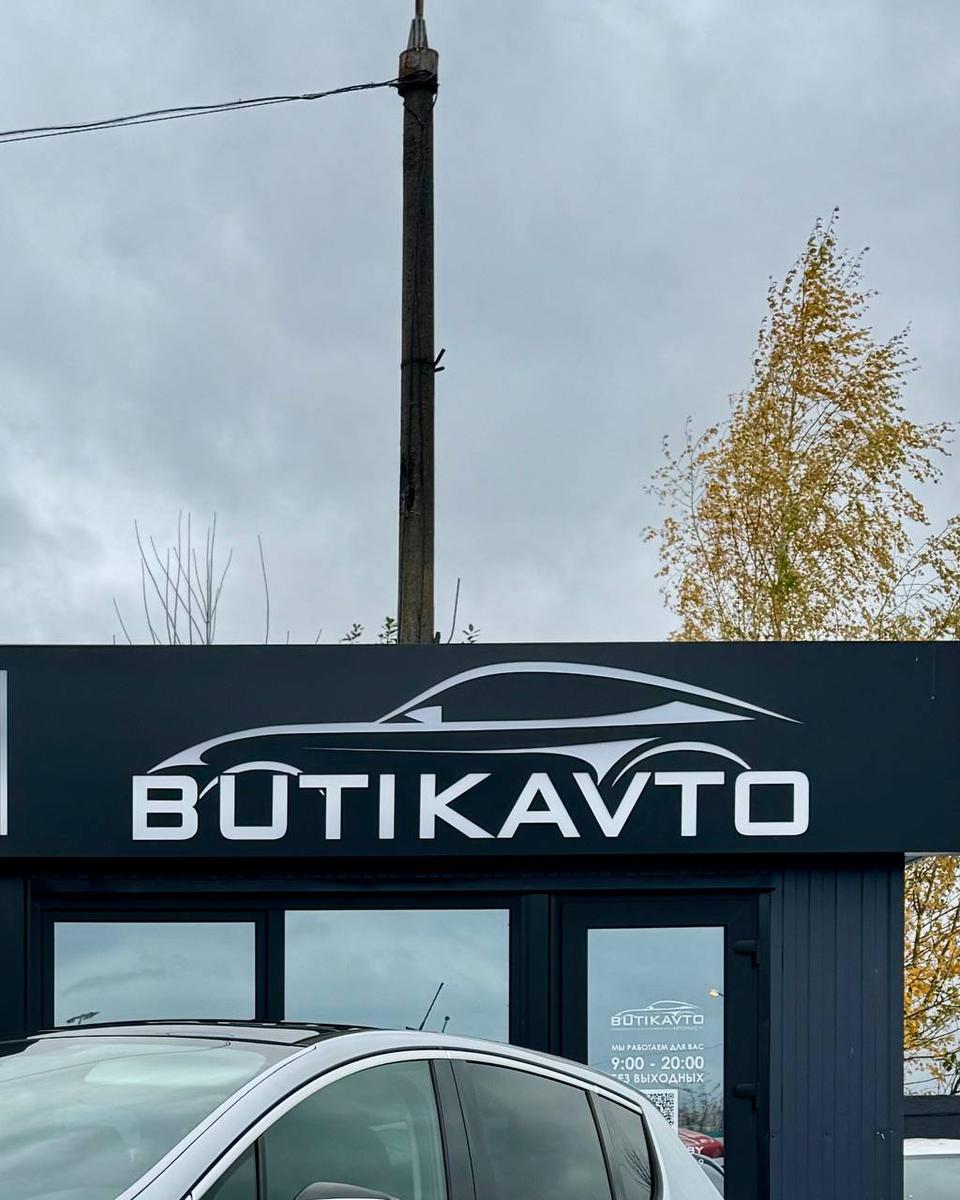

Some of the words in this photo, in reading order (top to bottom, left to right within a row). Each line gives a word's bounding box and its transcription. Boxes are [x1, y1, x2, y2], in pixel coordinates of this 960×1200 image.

[132, 770, 810, 841] BUTIKAVTO
[611, 1014, 704, 1026] BUTIKAVTO
[669, 1043, 686, 1051] ДЛЯ
[688, 1043, 704, 1051] ВАС
[611, 1057, 644, 1070] 9:00
[661, 1056, 704, 1070] 20:00
[611, 1073, 630, 1084] ЕЗ
[633, 1073, 704, 1084] ВЫХОДНЫХ
